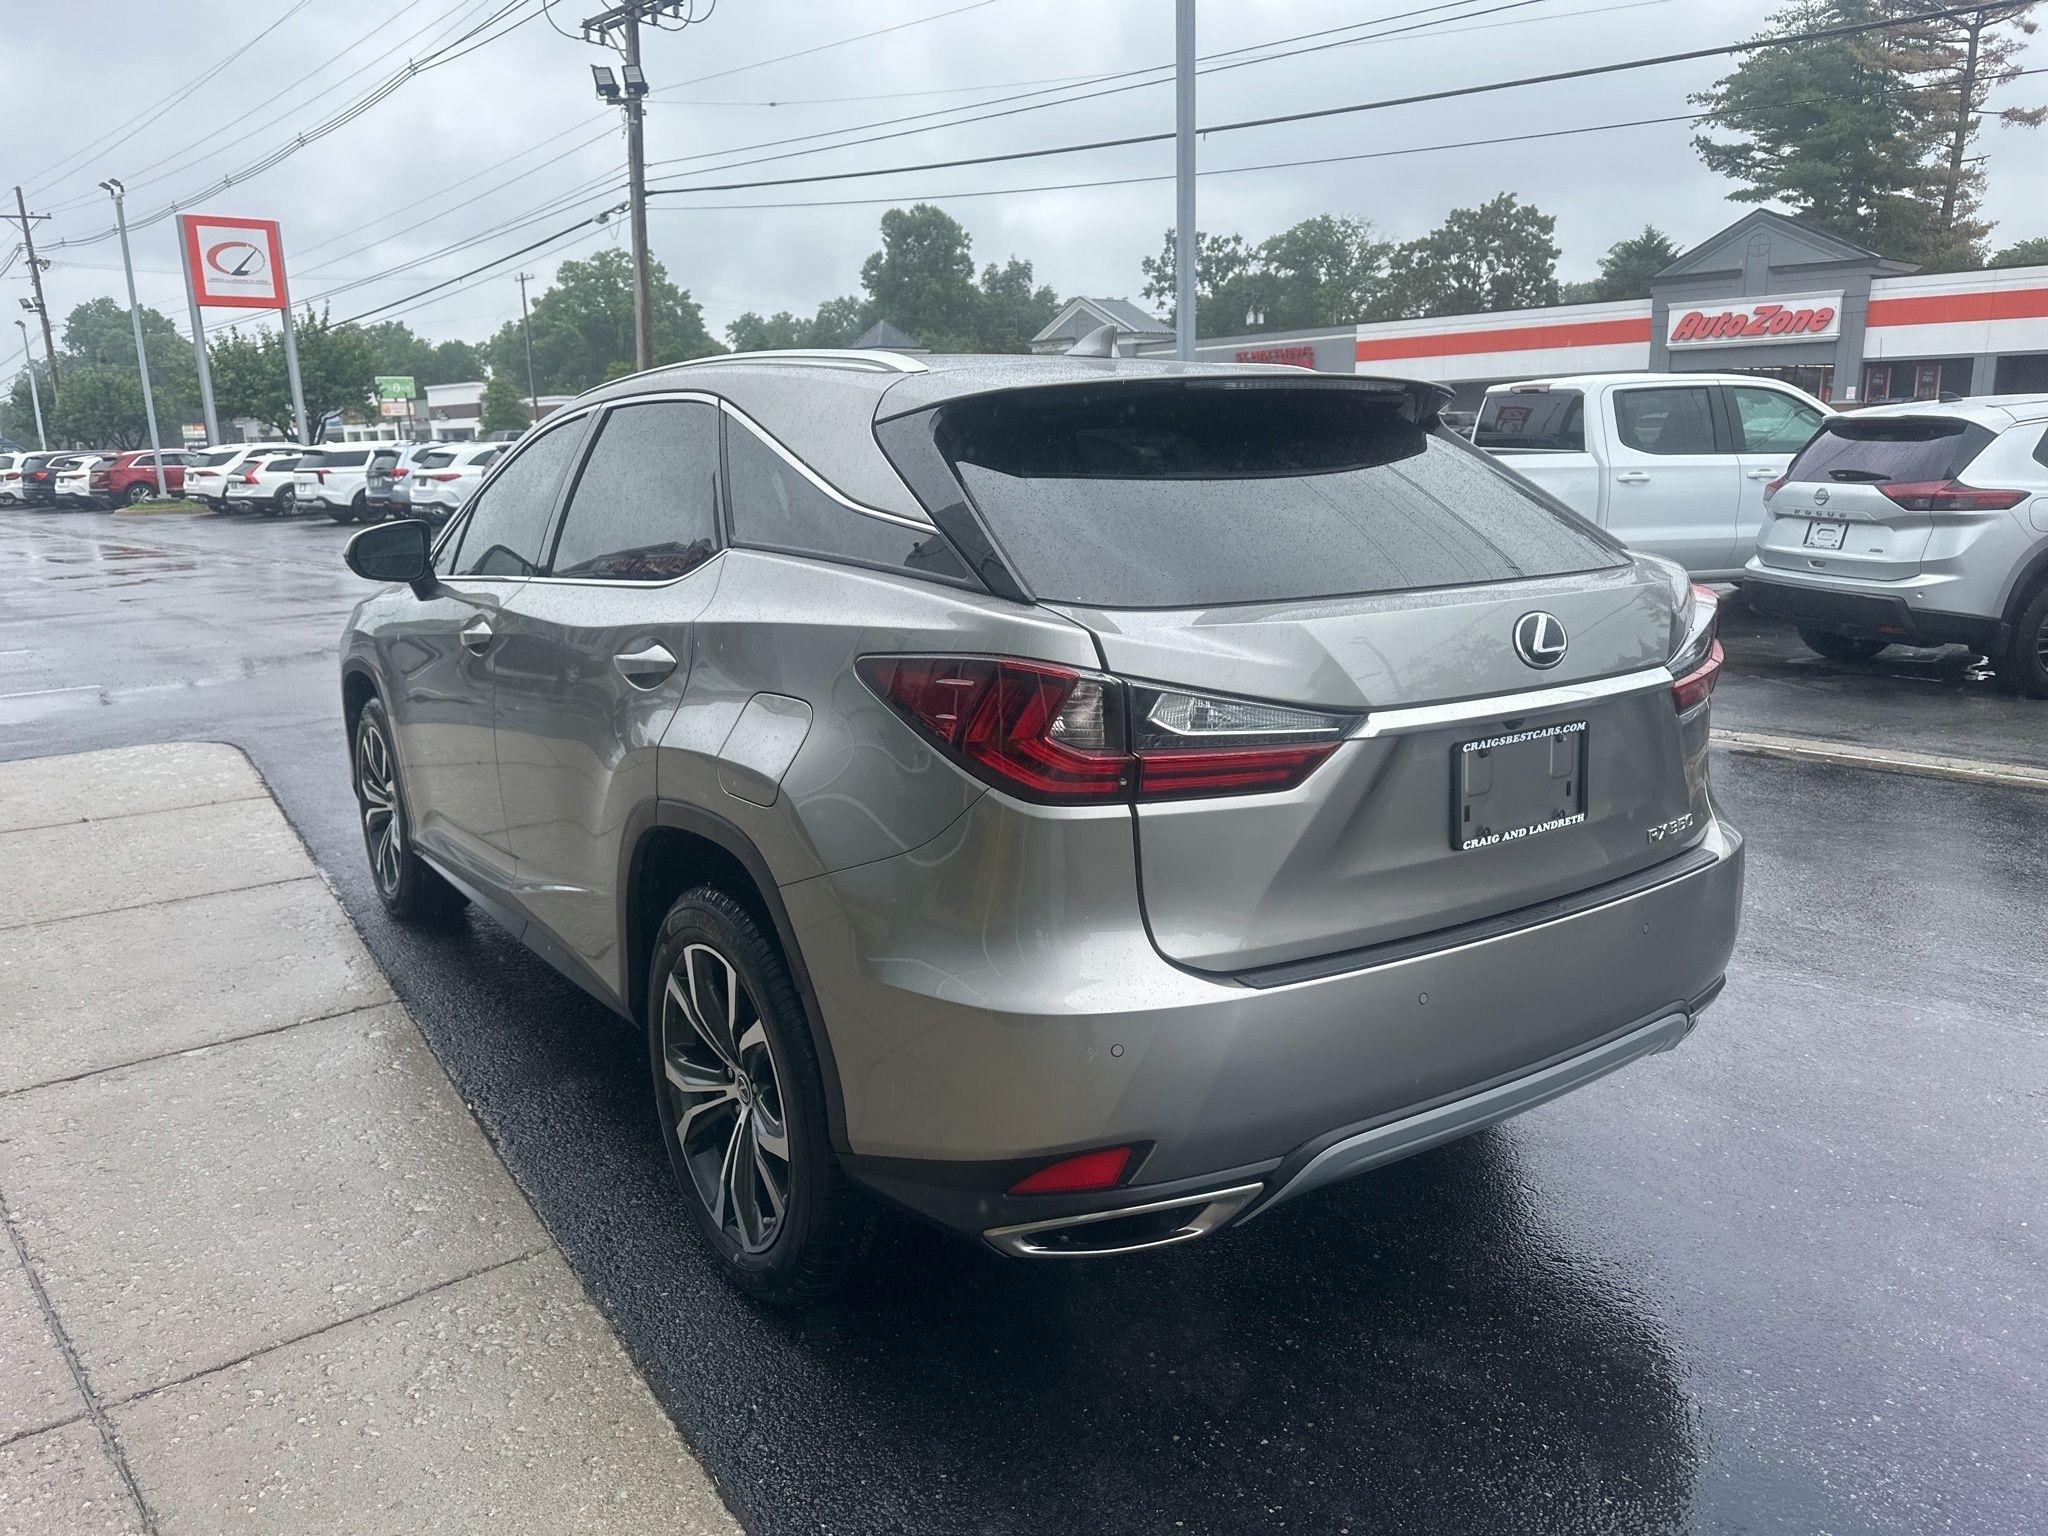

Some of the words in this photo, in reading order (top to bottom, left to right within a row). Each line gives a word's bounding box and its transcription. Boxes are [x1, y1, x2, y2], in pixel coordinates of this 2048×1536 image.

[1670, 304, 1835, 342] AutoZone
[1794, 509, 1847, 518] ROGUE
[1462, 721, 1587, 753] CRAIGSBESTCARS.COM
[1462, 834, 1500, 850] CRAIG
[1501, 827, 1527, 842] AND
[1528, 813, 1585, 836] LANDRETH
[1646, 823, 1668, 844] RX
